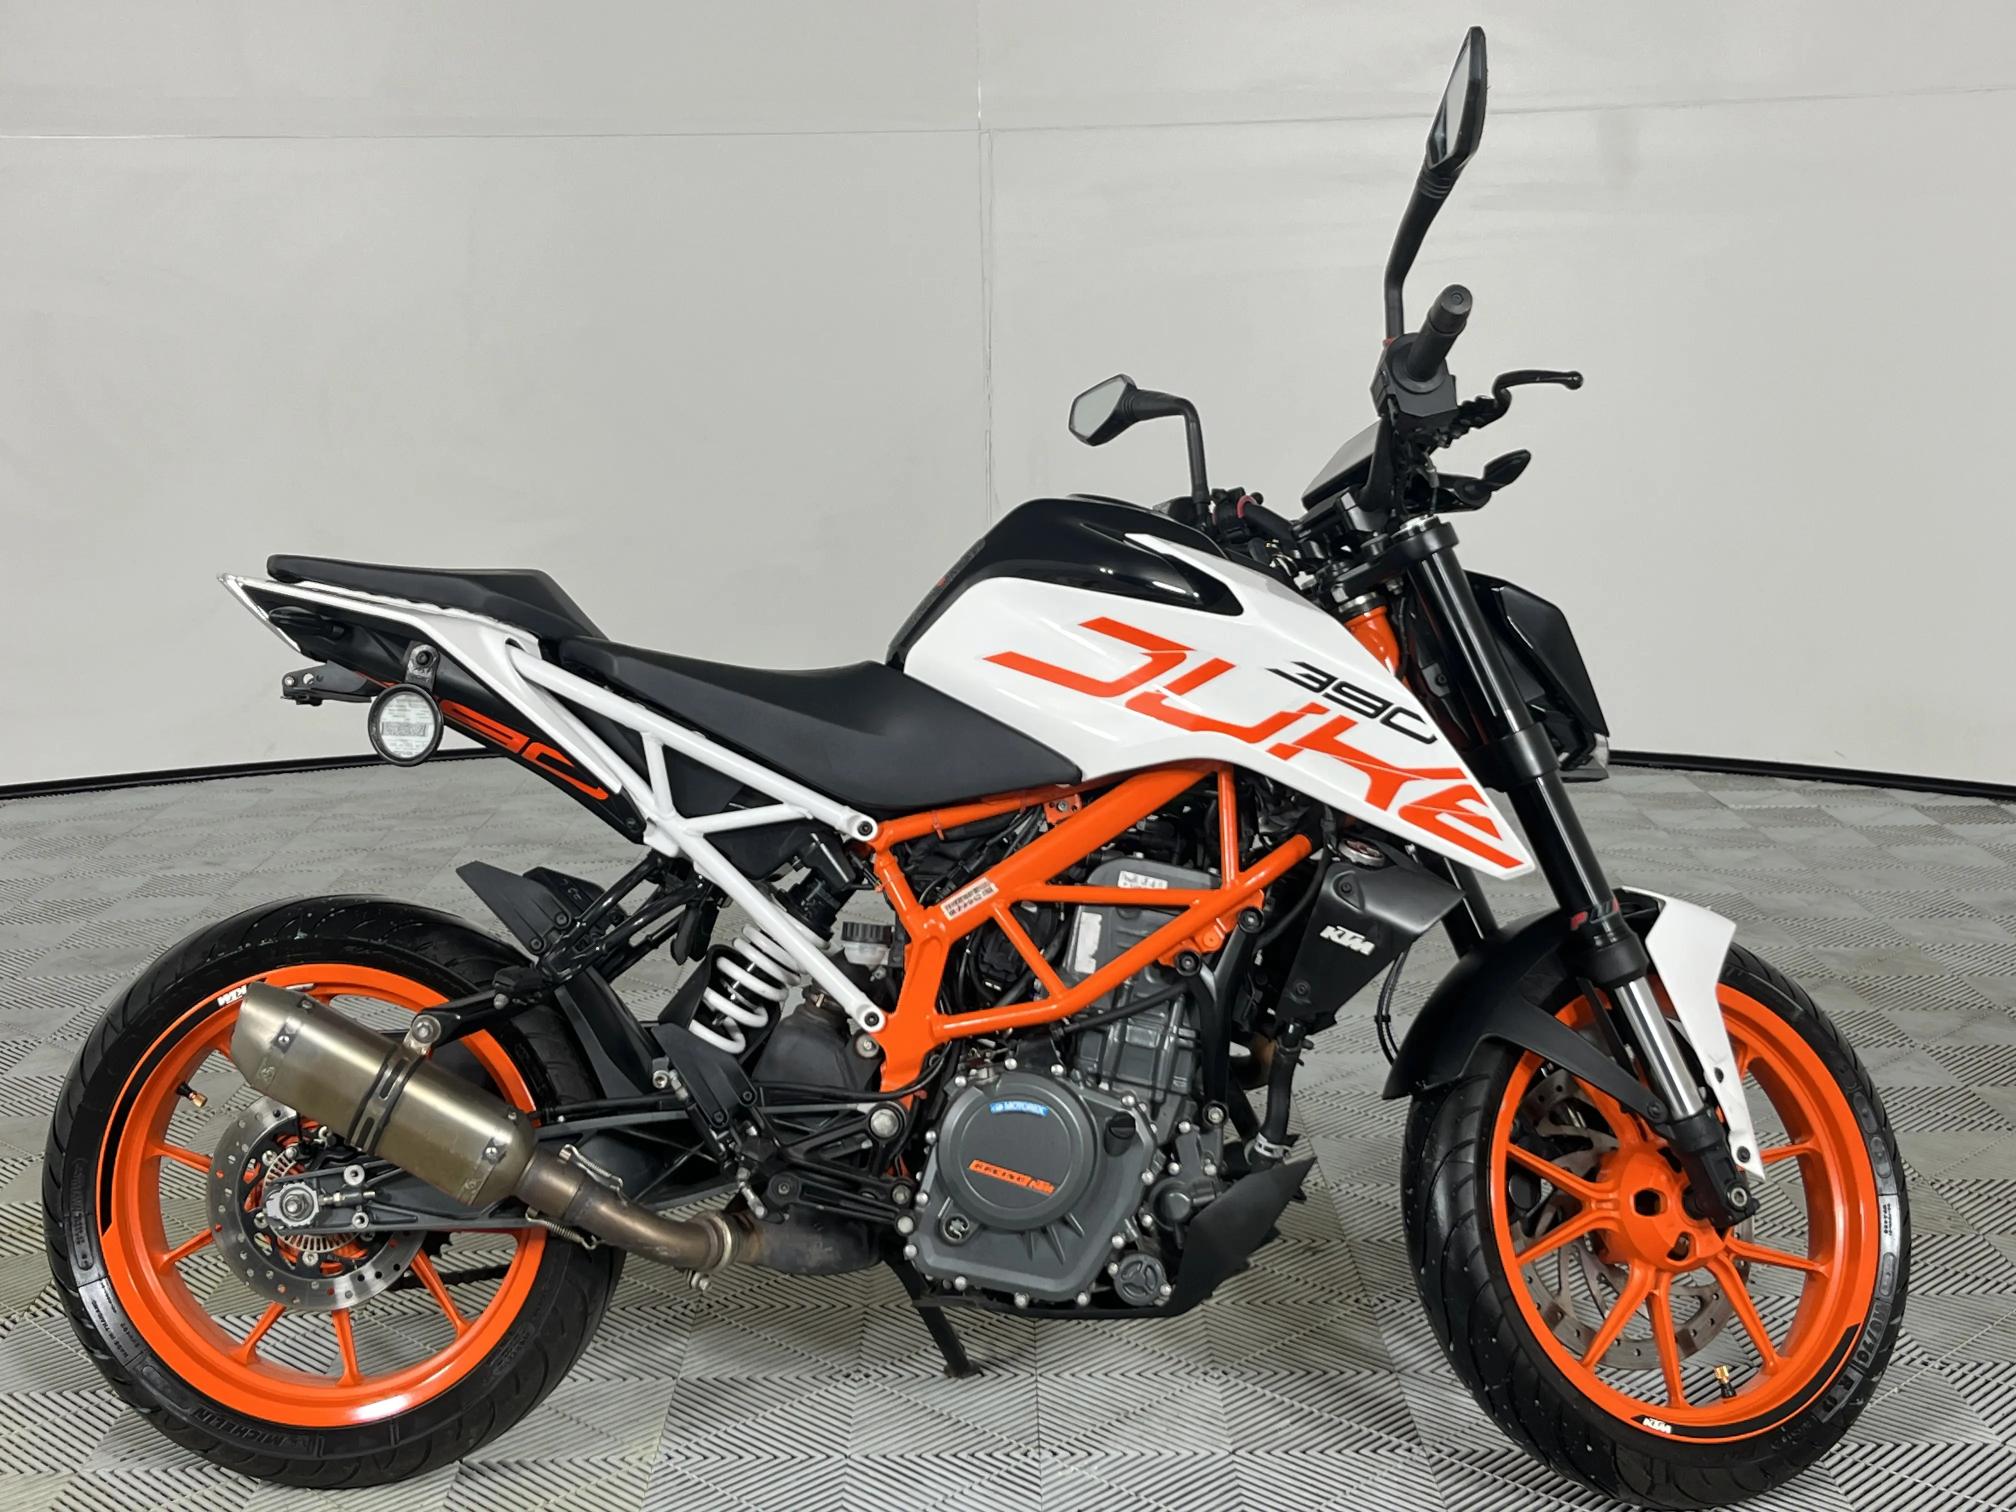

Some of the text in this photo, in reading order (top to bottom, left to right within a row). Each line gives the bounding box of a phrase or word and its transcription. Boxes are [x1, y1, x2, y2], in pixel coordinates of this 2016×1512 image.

[983, 616, 1522, 869] DUKE
[1264, 661, 1438, 745] 390
[1319, 925, 1375, 956] KTM
